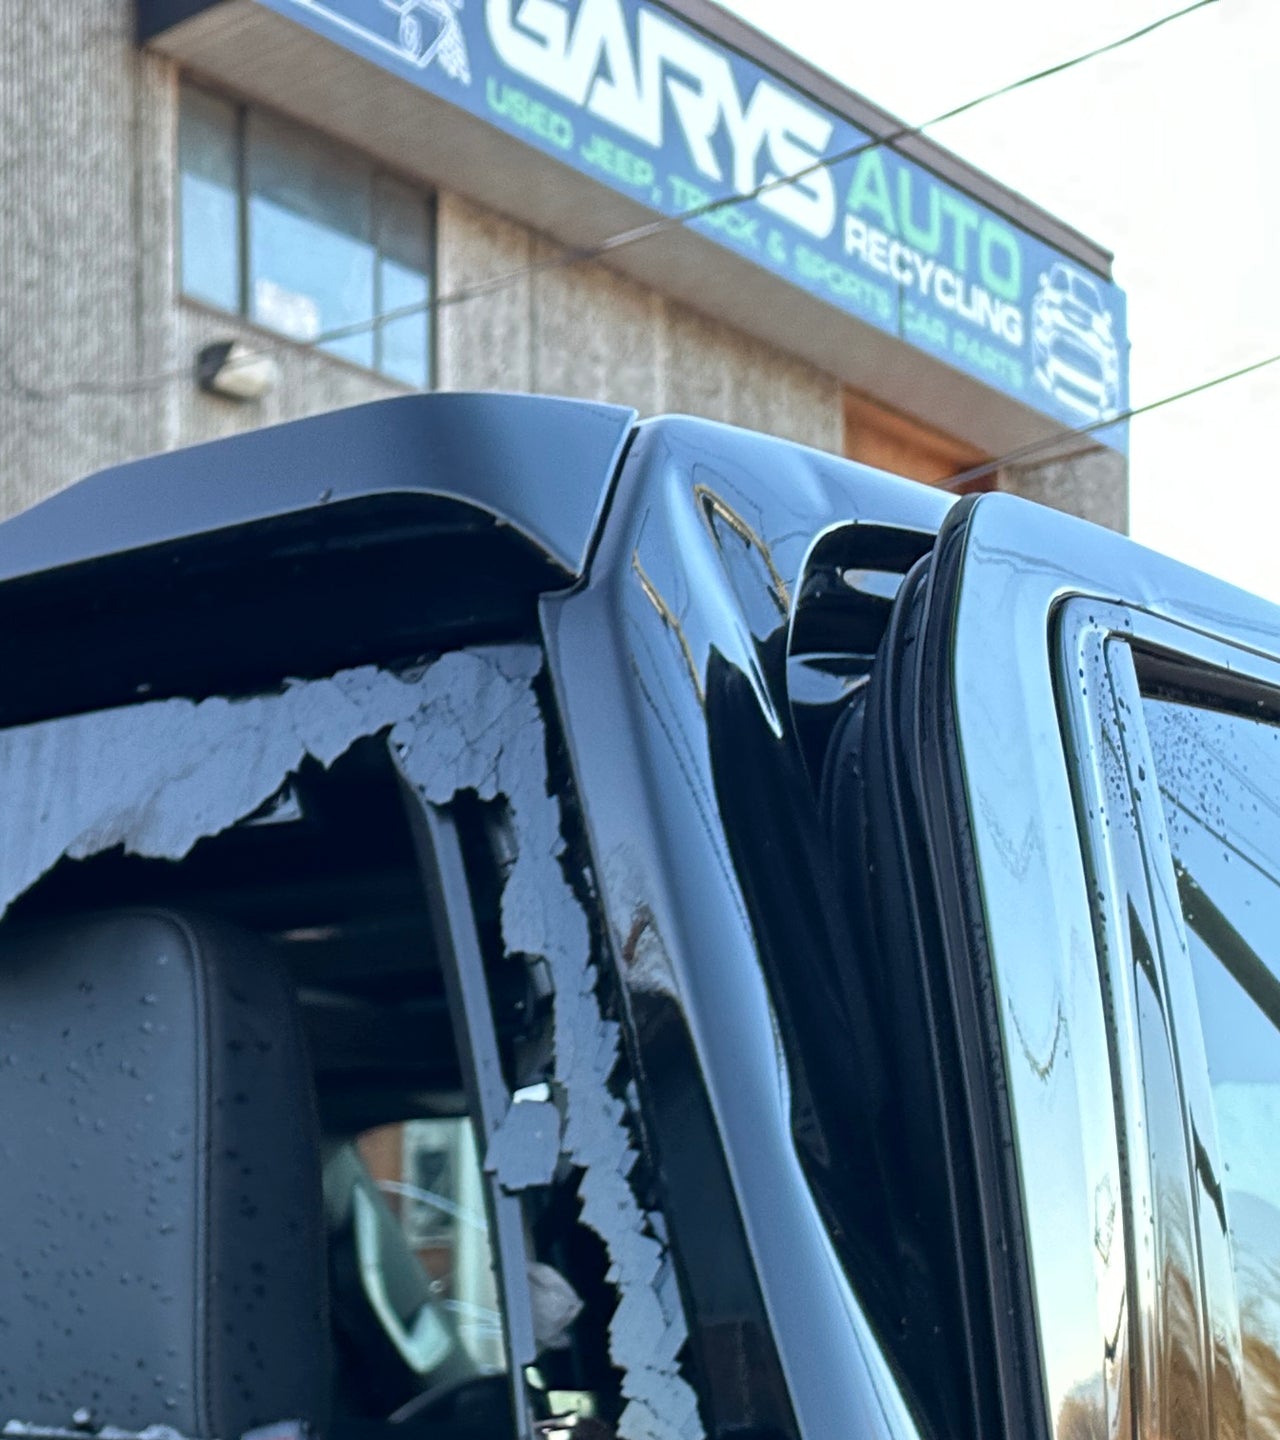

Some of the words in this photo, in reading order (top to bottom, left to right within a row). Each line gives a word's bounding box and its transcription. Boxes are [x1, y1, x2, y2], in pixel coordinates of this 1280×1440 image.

[484, 0, 836, 240] GARYS
[485, 74, 574, 151] USED
[667, 173, 760, 249] TRUCK
[765, 227, 787, 262] &
[795, 245, 891, 321] SPORTS
[902, 300, 948, 348] CAR
[952, 331, 1024, 390] PARTS
[844, 213, 1024, 347] RECYCLING
[846, 148, 1022, 302] AUTO
